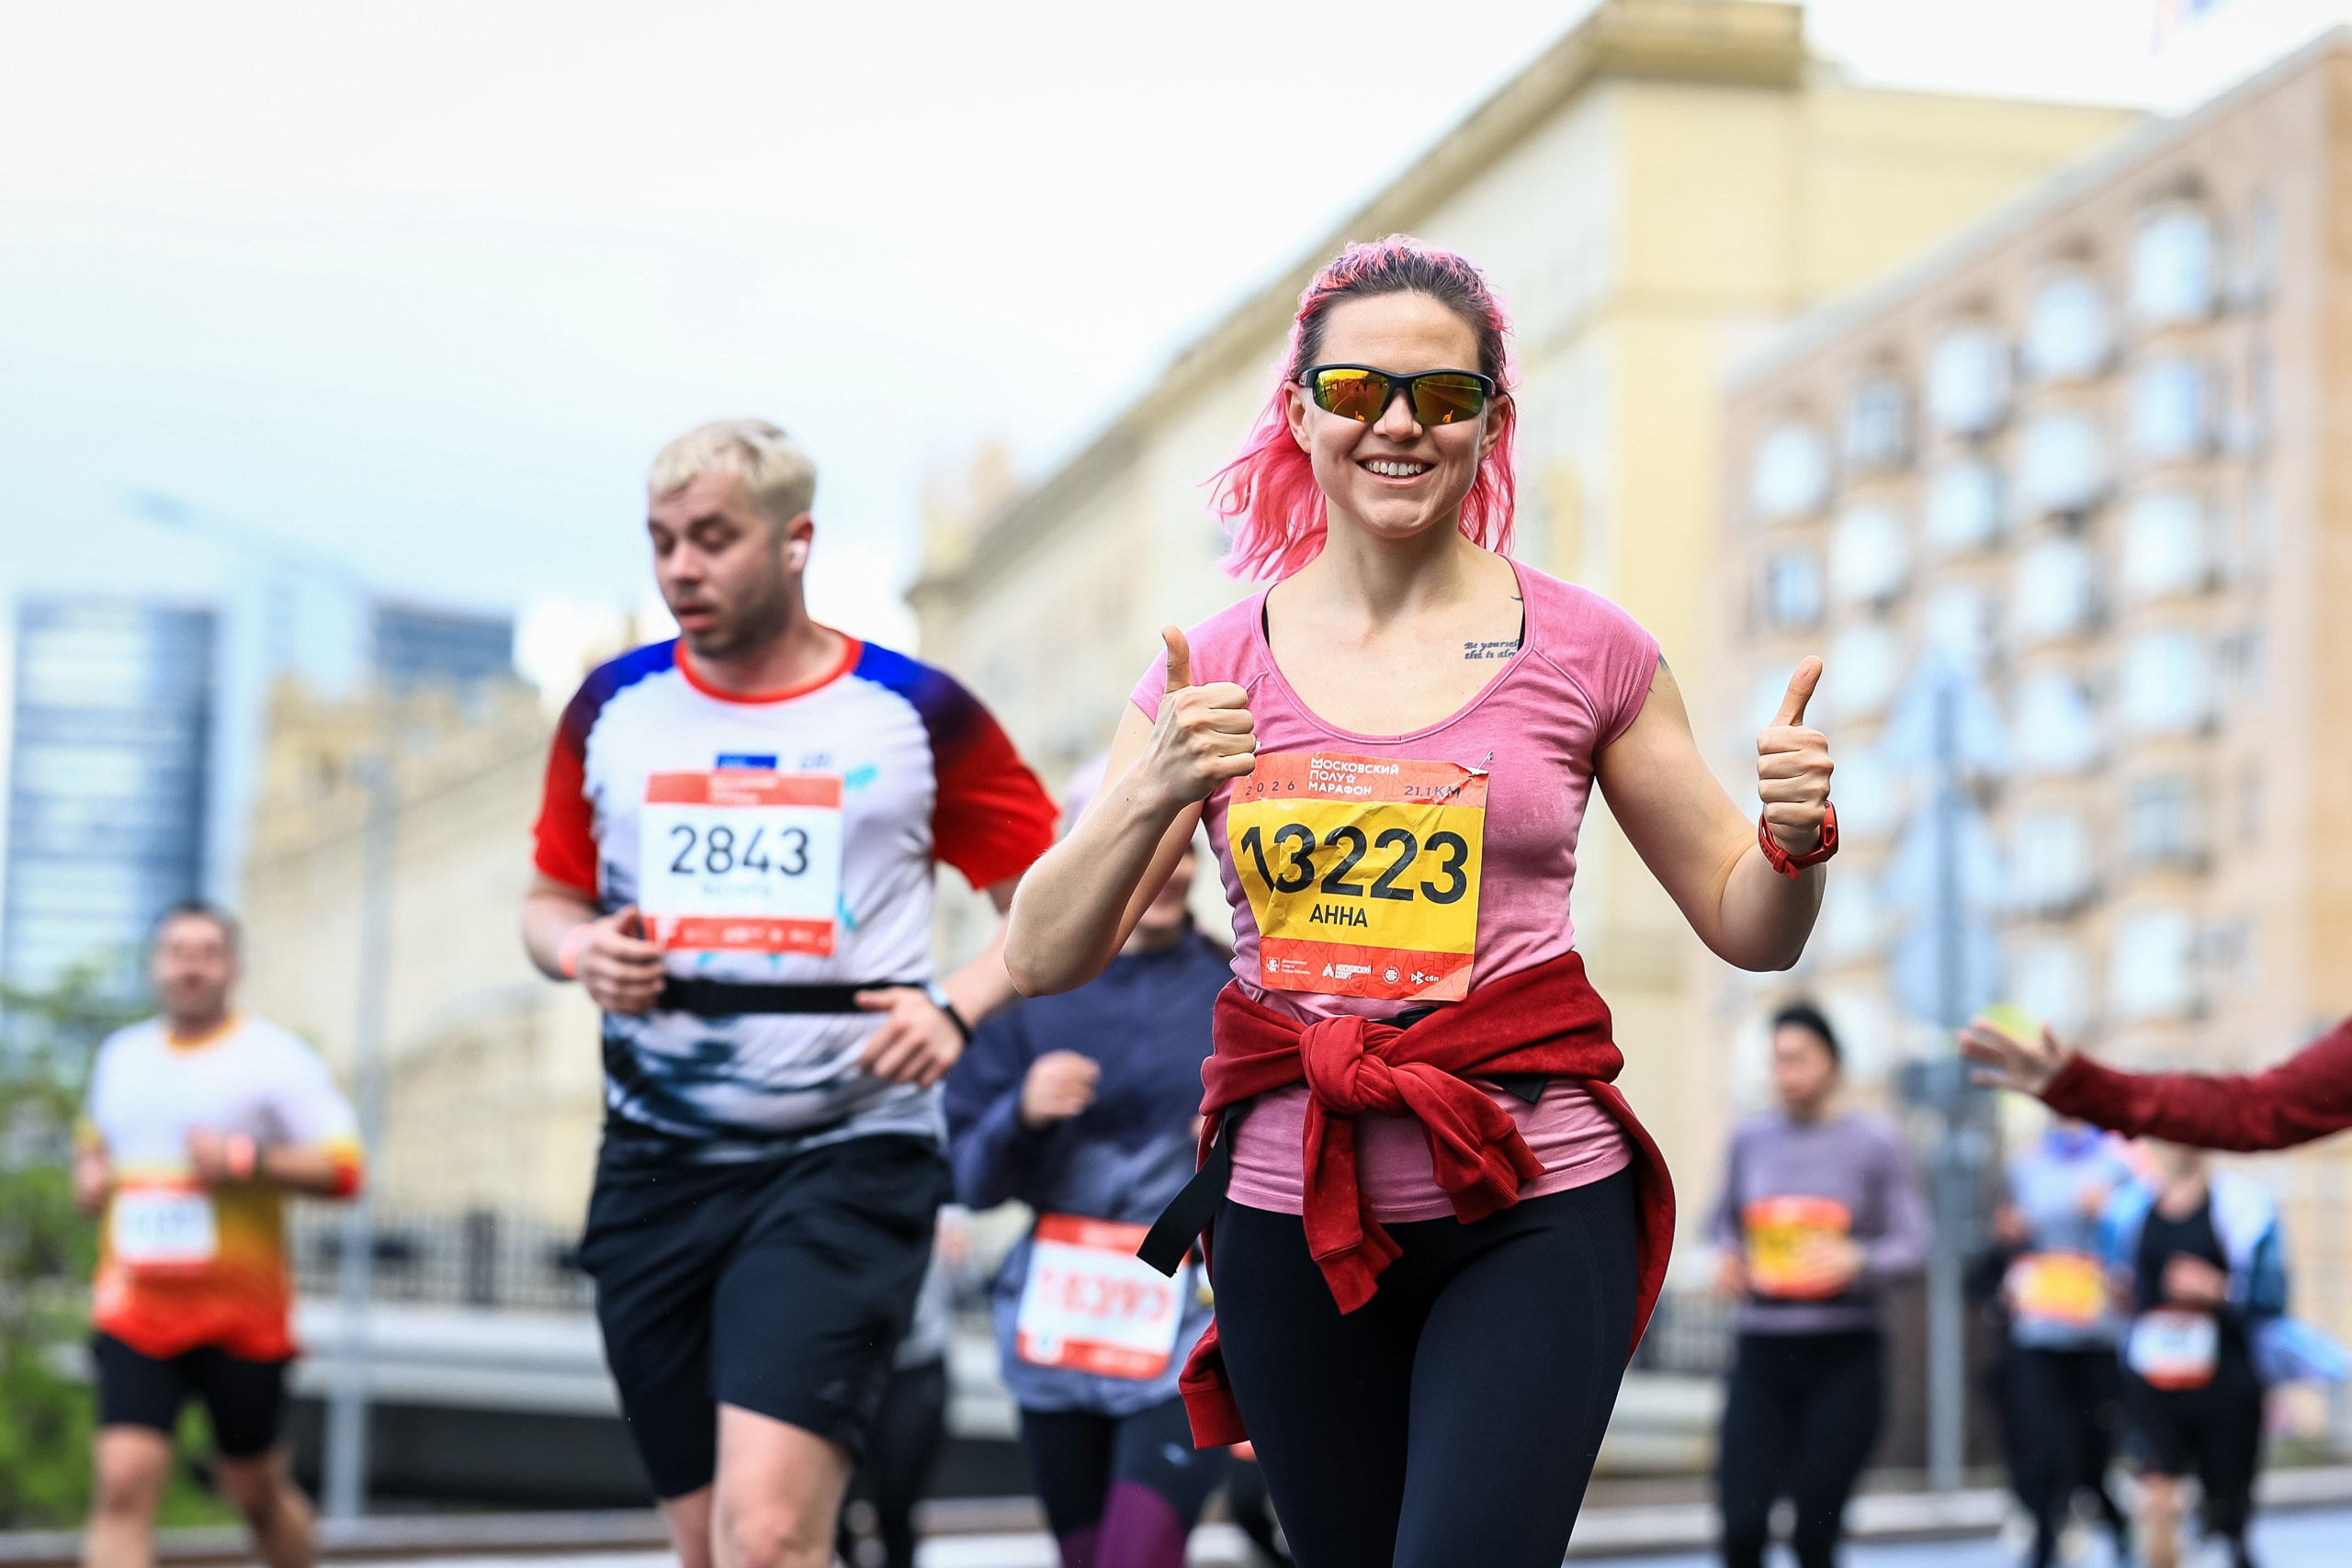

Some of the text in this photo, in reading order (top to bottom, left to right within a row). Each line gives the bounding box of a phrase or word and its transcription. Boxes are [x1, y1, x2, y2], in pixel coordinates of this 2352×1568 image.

[1464, 638, 1520, 652] Be yoursel
[1486, 650, 1494, 659] is
[1310, 756, 1400, 775] МОСКОВСКИЙ
[1308, 769, 1346, 782] ПОЛУ
[1245, 780, 1295, 796] 2026
[1307, 781, 1373, 796] МАРАФОН
[670, 824, 809, 876] 2843
[1240, 823, 1469, 905] 13223
[1309, 903, 1368, 928] АННА
